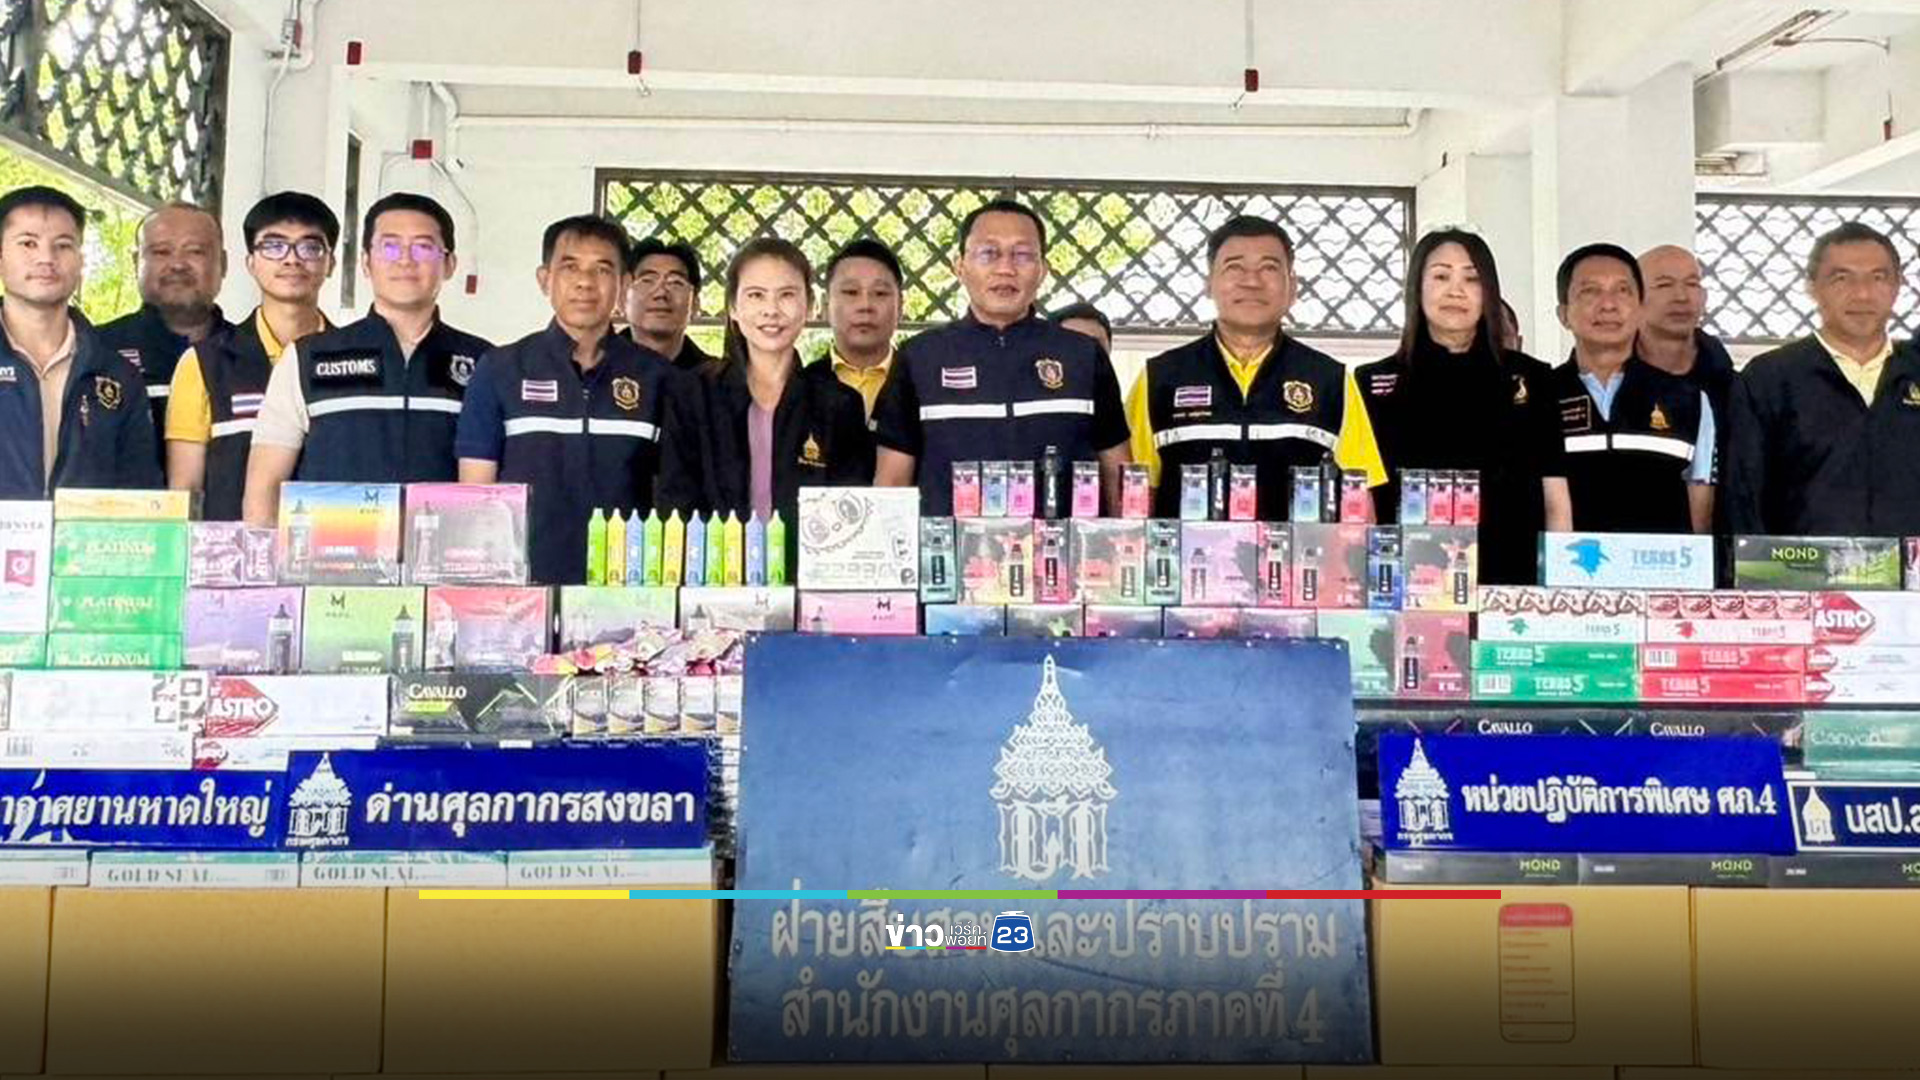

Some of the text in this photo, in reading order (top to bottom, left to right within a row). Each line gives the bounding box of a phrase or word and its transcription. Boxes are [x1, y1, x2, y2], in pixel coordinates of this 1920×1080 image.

[315, 358, 377, 376] CUSTOMS
[1680, 545, 1693, 569] 5
[1771, 547, 1819, 560] MOND
[1814, 609, 1872, 629] ASTRO
[409, 683, 468, 700] CAVALLO
[210, 697, 274, 719] ASTRO
[1477, 719, 1534, 735] CAVALLO
[1650, 721, 1705, 737] CAVALLO
[1460, 774, 1711, 823] หน่วยปฏิบัติการพิเศษ
[365, 783, 696, 838] ด่านศุลกากรสงขลา
[520, 865, 572, 880] GOLD
[1519, 858, 1561, 871] MOND
[1711, 860, 1753, 871] MOND
[107, 868, 160, 882] GOLD
[313, 867, 365, 881] GOLD
[782, 960, 1325, 1058] สำนักงานศุลกากรภาคที่ 4
